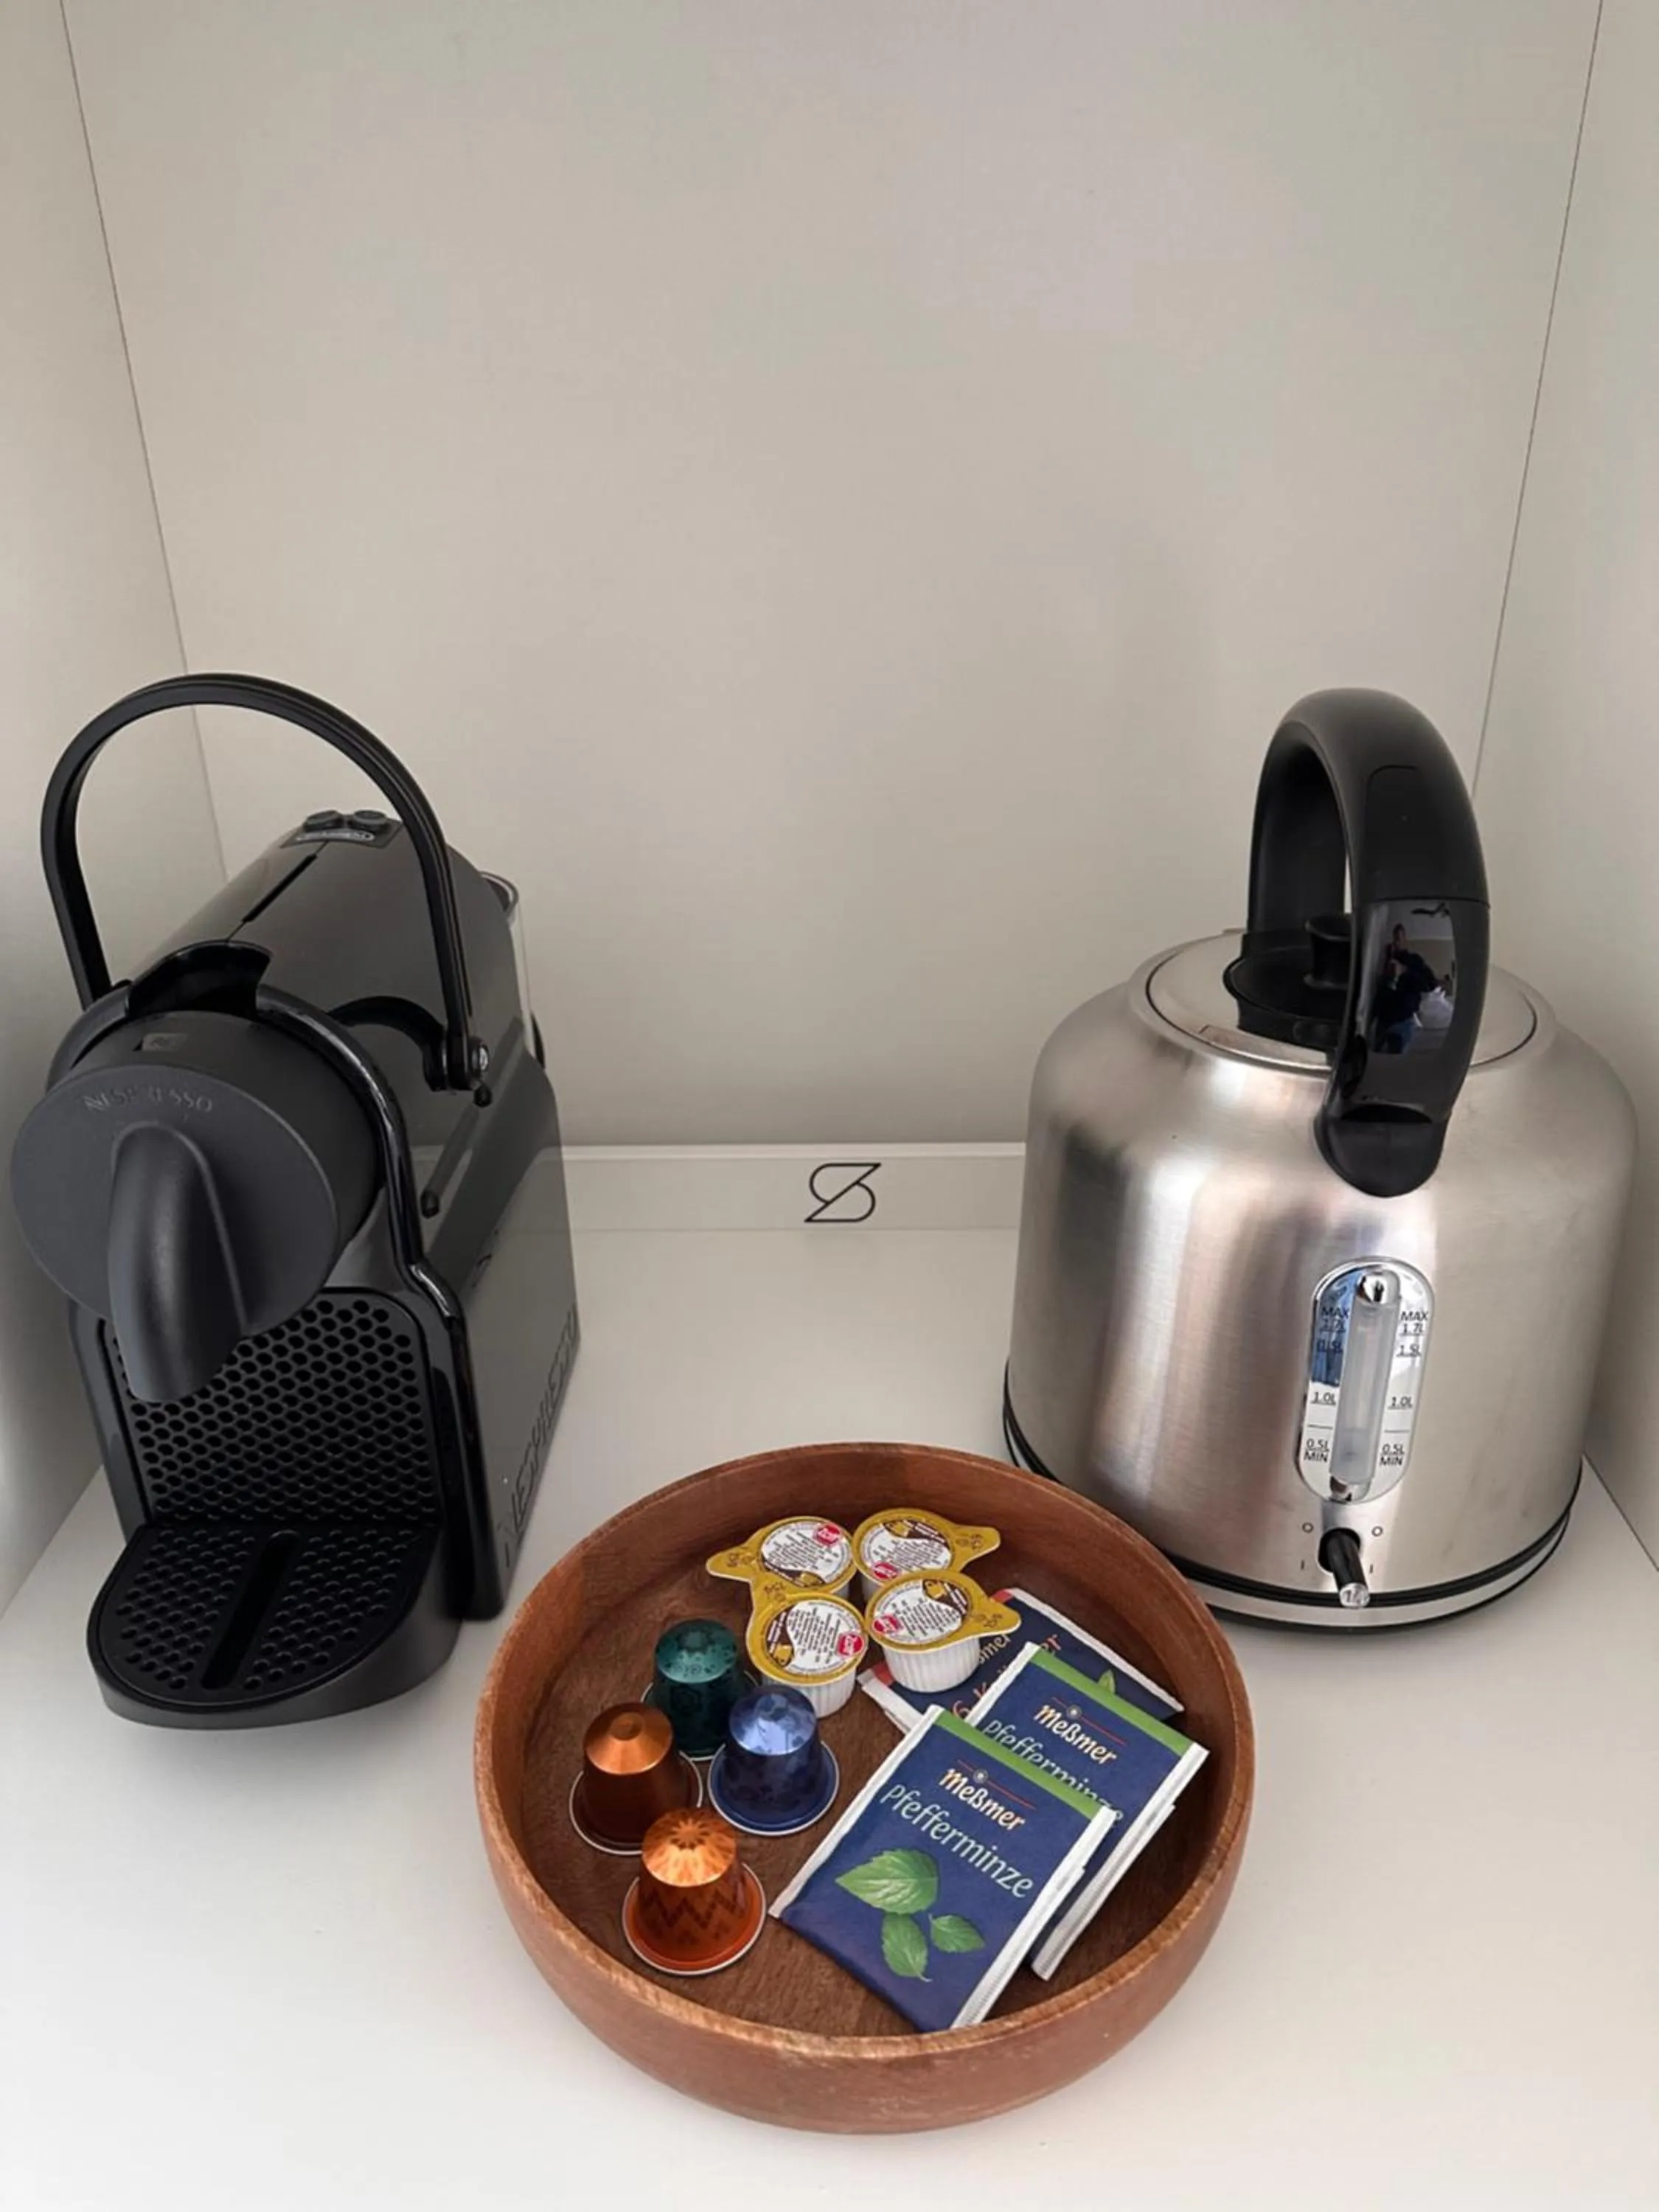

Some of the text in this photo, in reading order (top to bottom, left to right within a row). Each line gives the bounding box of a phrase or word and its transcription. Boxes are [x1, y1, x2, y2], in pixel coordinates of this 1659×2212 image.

[1400, 1310, 1429, 1321] MAX
[1313, 1391, 1336, 1405] 1.0L
[1390, 1397, 1413, 1408] 1.0L
[1306, 1439, 1329, 1451] 0.5L
[1382, 1444, 1405, 1455] 0.5L
[1304, 1450, 1328, 1462] MIN
[1380, 1455, 1402, 1466] MIN
[1033, 1704, 1118, 1764] Meßmer
[939, 1767, 1026, 1831] Meßmer
[880, 1784, 1034, 1898] Pfefferminze
